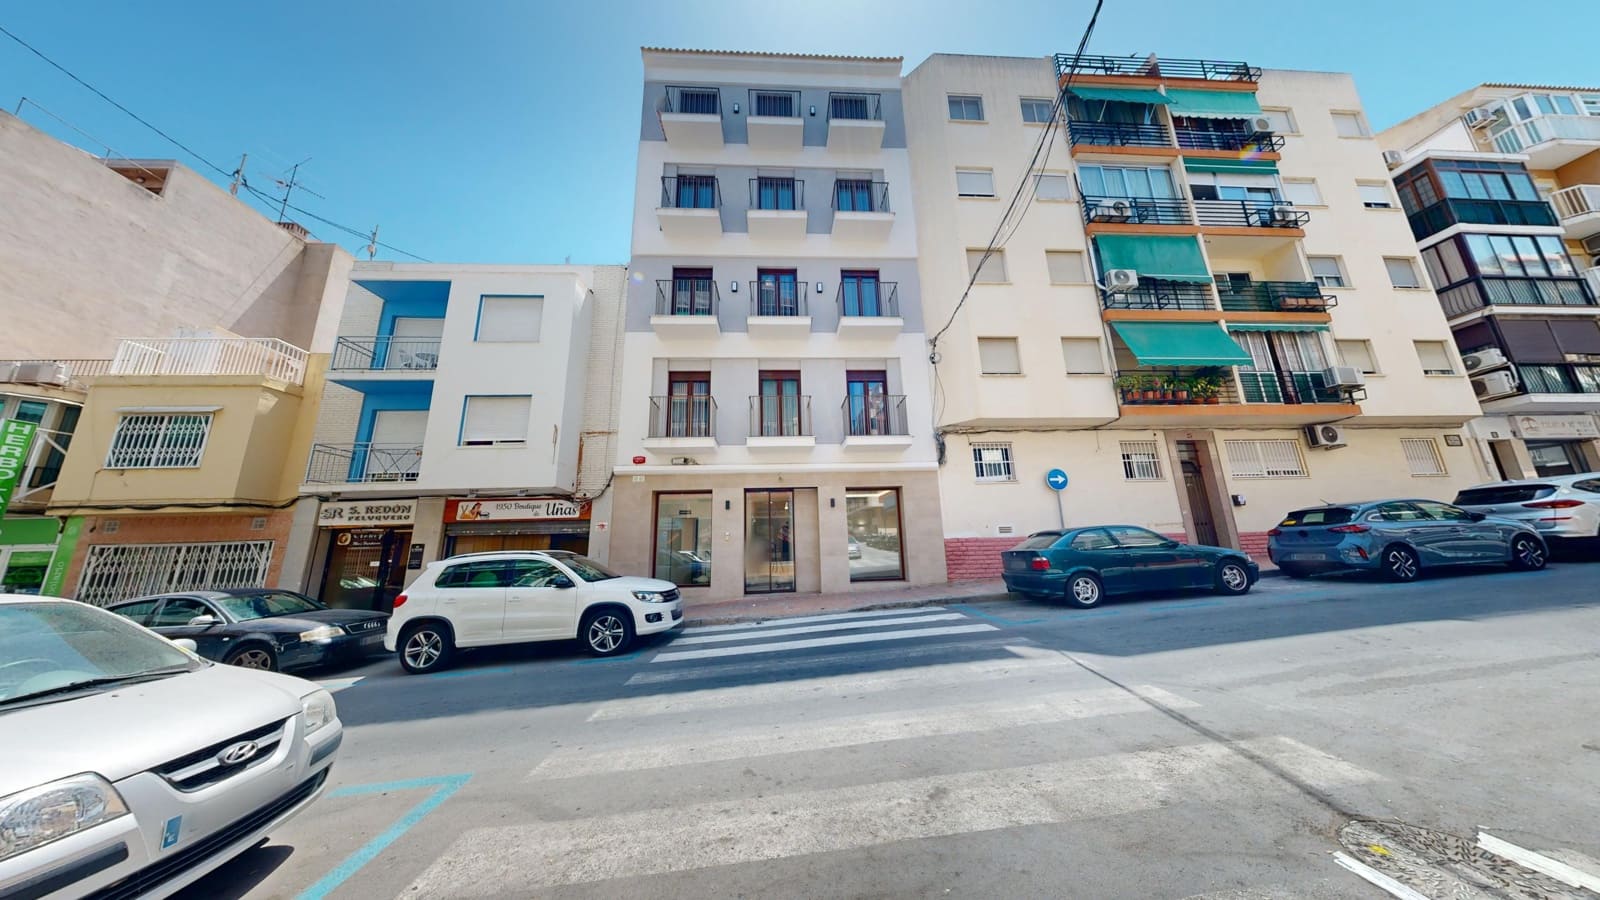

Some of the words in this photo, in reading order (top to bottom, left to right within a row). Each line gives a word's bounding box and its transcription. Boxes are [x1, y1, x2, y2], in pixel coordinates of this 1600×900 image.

[0, 422, 32, 511] HERBO
[496, 503, 512, 511] 1950
[514, 502, 541, 512] Boutique
[545, 502, 577, 516] Uñas
